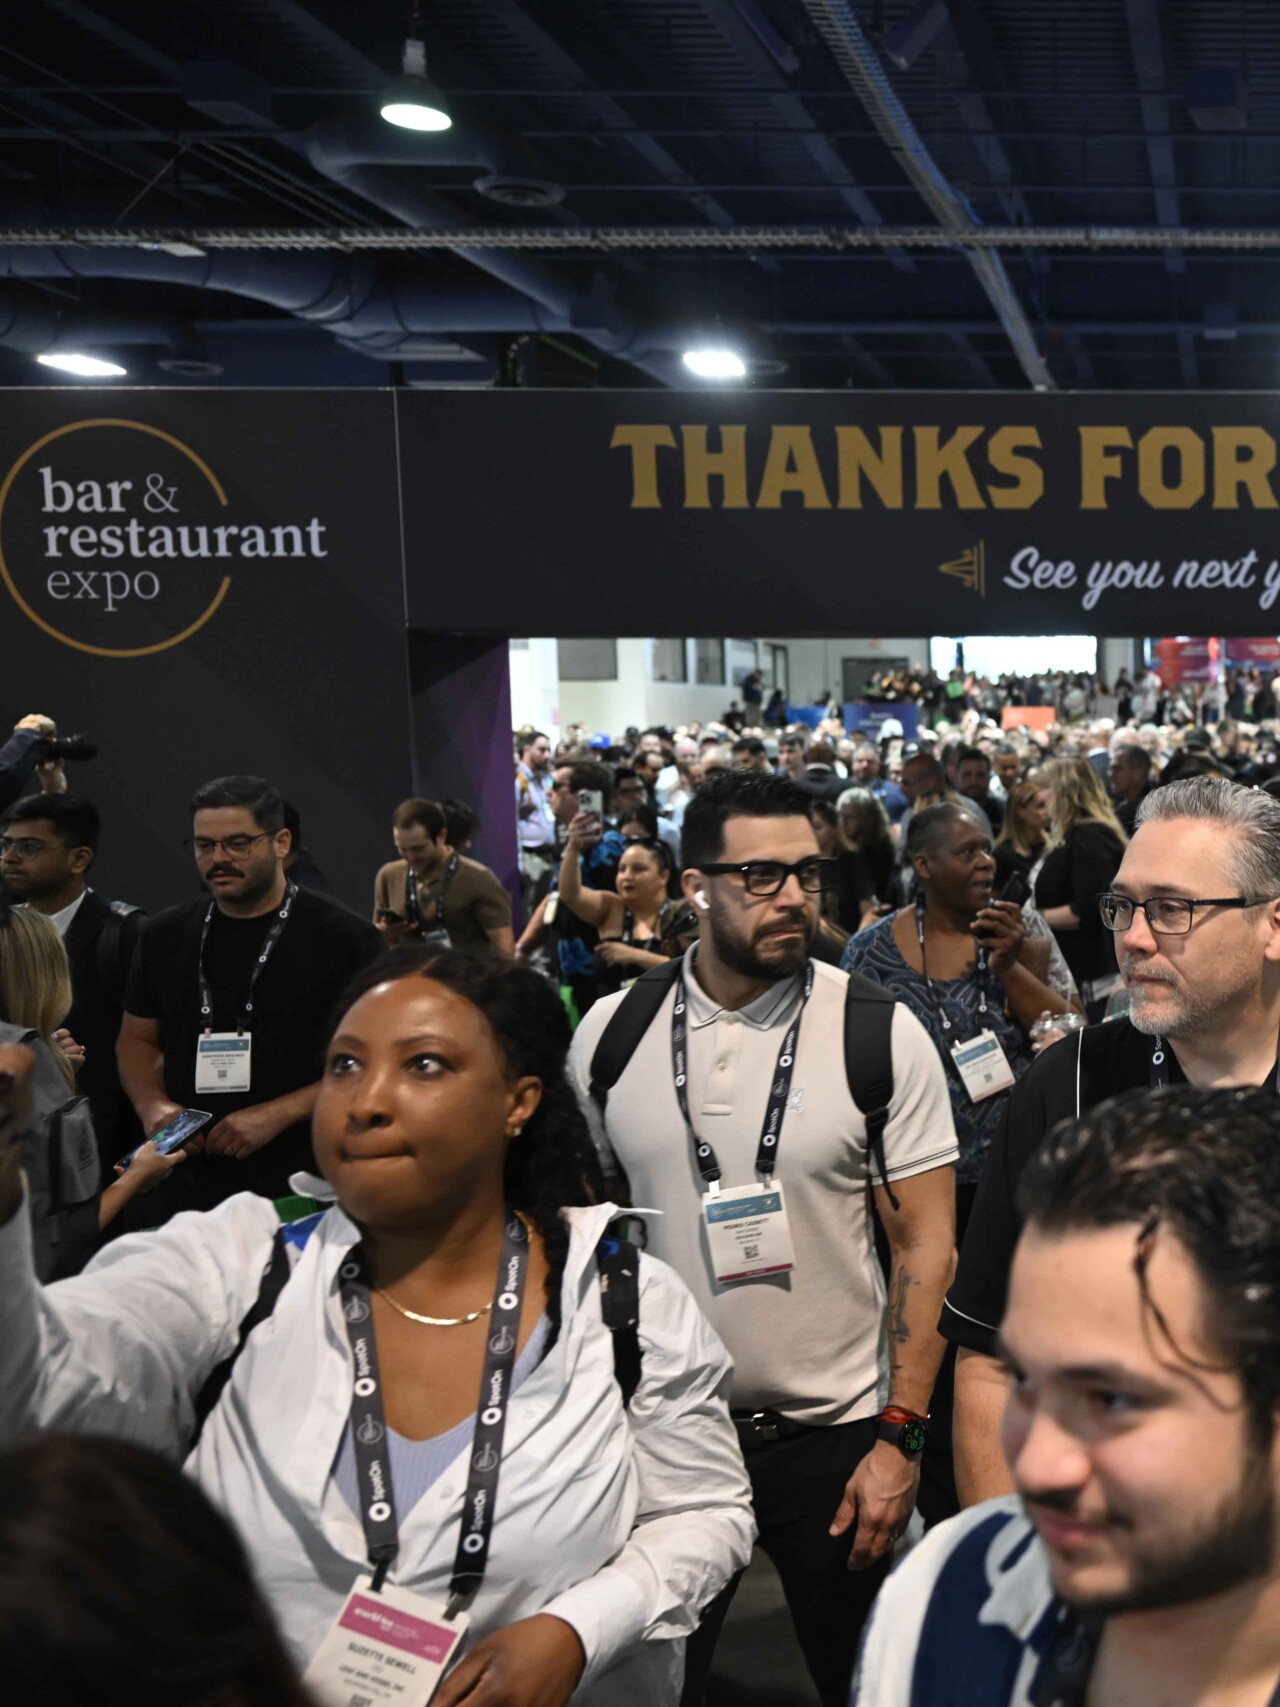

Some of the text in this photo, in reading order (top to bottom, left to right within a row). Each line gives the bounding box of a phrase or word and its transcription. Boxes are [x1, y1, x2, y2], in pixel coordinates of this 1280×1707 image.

[610, 425, 1044, 509] THANKS
[1080, 426, 1278, 509] FOR
[38, 467, 178, 513] bar &
[44, 517, 328, 558] restaurant
[46, 570, 160, 612] expo
[1003, 546, 1077, 590] See
[1082, 559, 1164, 611] you
[1172, 549, 1257, 589] next
[503, 1255, 520, 1293] SpotOn
[356, 1337, 368, 1378] SpotOn
[488, 1369, 503, 1409] SpotOn
[371, 1459, 386, 1502] SpotOn
[471, 1489, 488, 1533] SpotOn
[348, 1642, 384, 1662] SUZETTE
[384, 1655, 417, 1675] SEWELL
